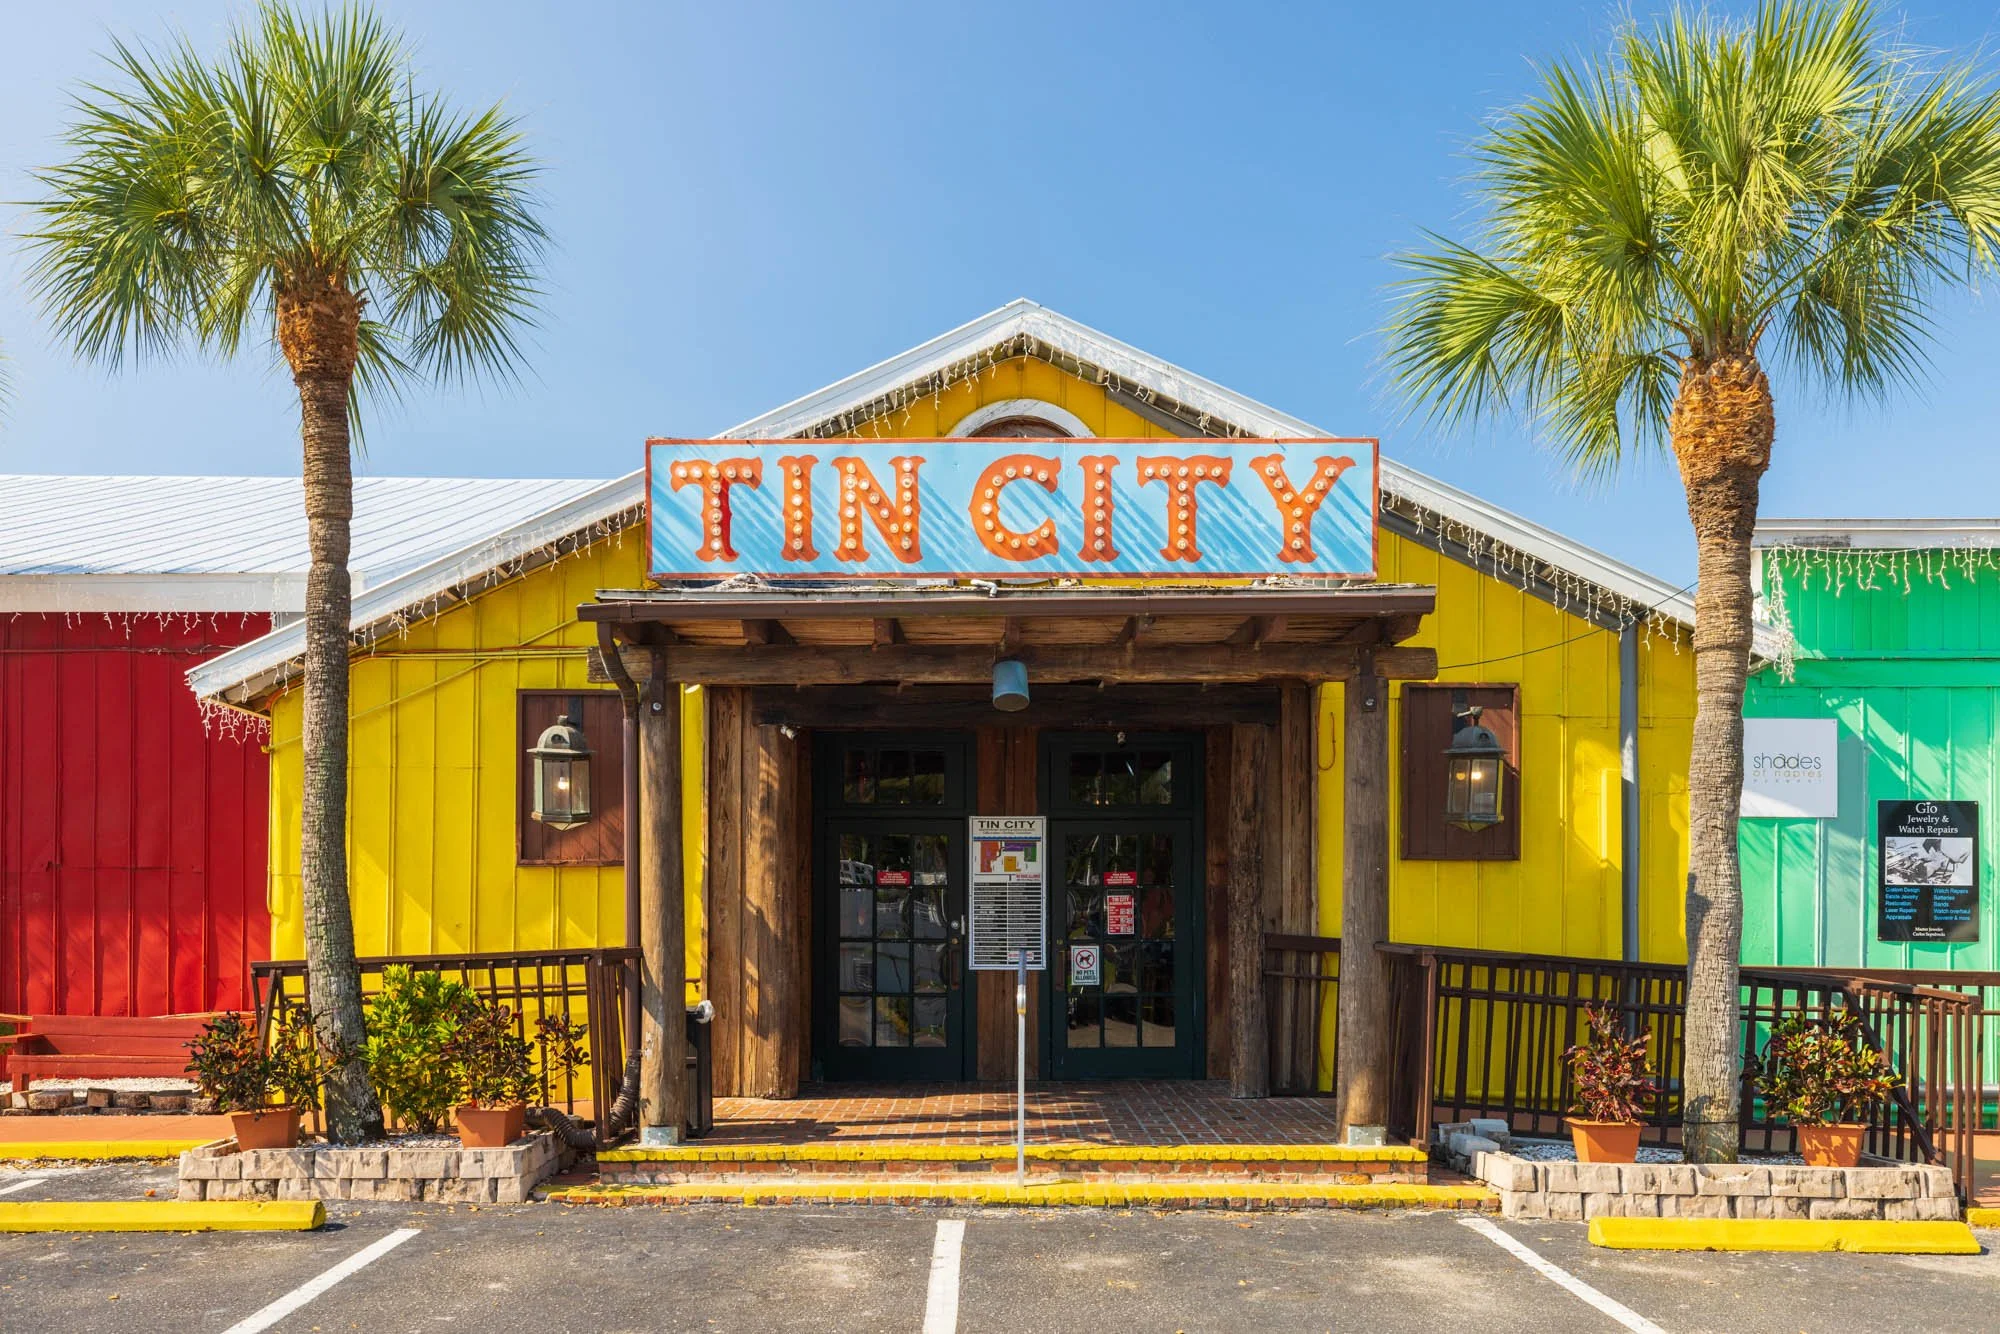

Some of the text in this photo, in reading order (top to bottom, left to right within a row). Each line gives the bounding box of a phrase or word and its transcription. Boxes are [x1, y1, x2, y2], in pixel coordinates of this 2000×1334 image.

[670, 453, 1357, 564] TIN CITY
[1753, 752, 1822, 769] shades
[1752, 769, 1822, 778] of naples
[1915, 802, 1938, 814] Gio
[978, 820, 1036, 829] TIN CITY
[1907, 815, 1950, 825] Jewelry &
[1898, 825, 1959, 836] Watch Repairs
[1950, 887, 1969, 895] Repairs
